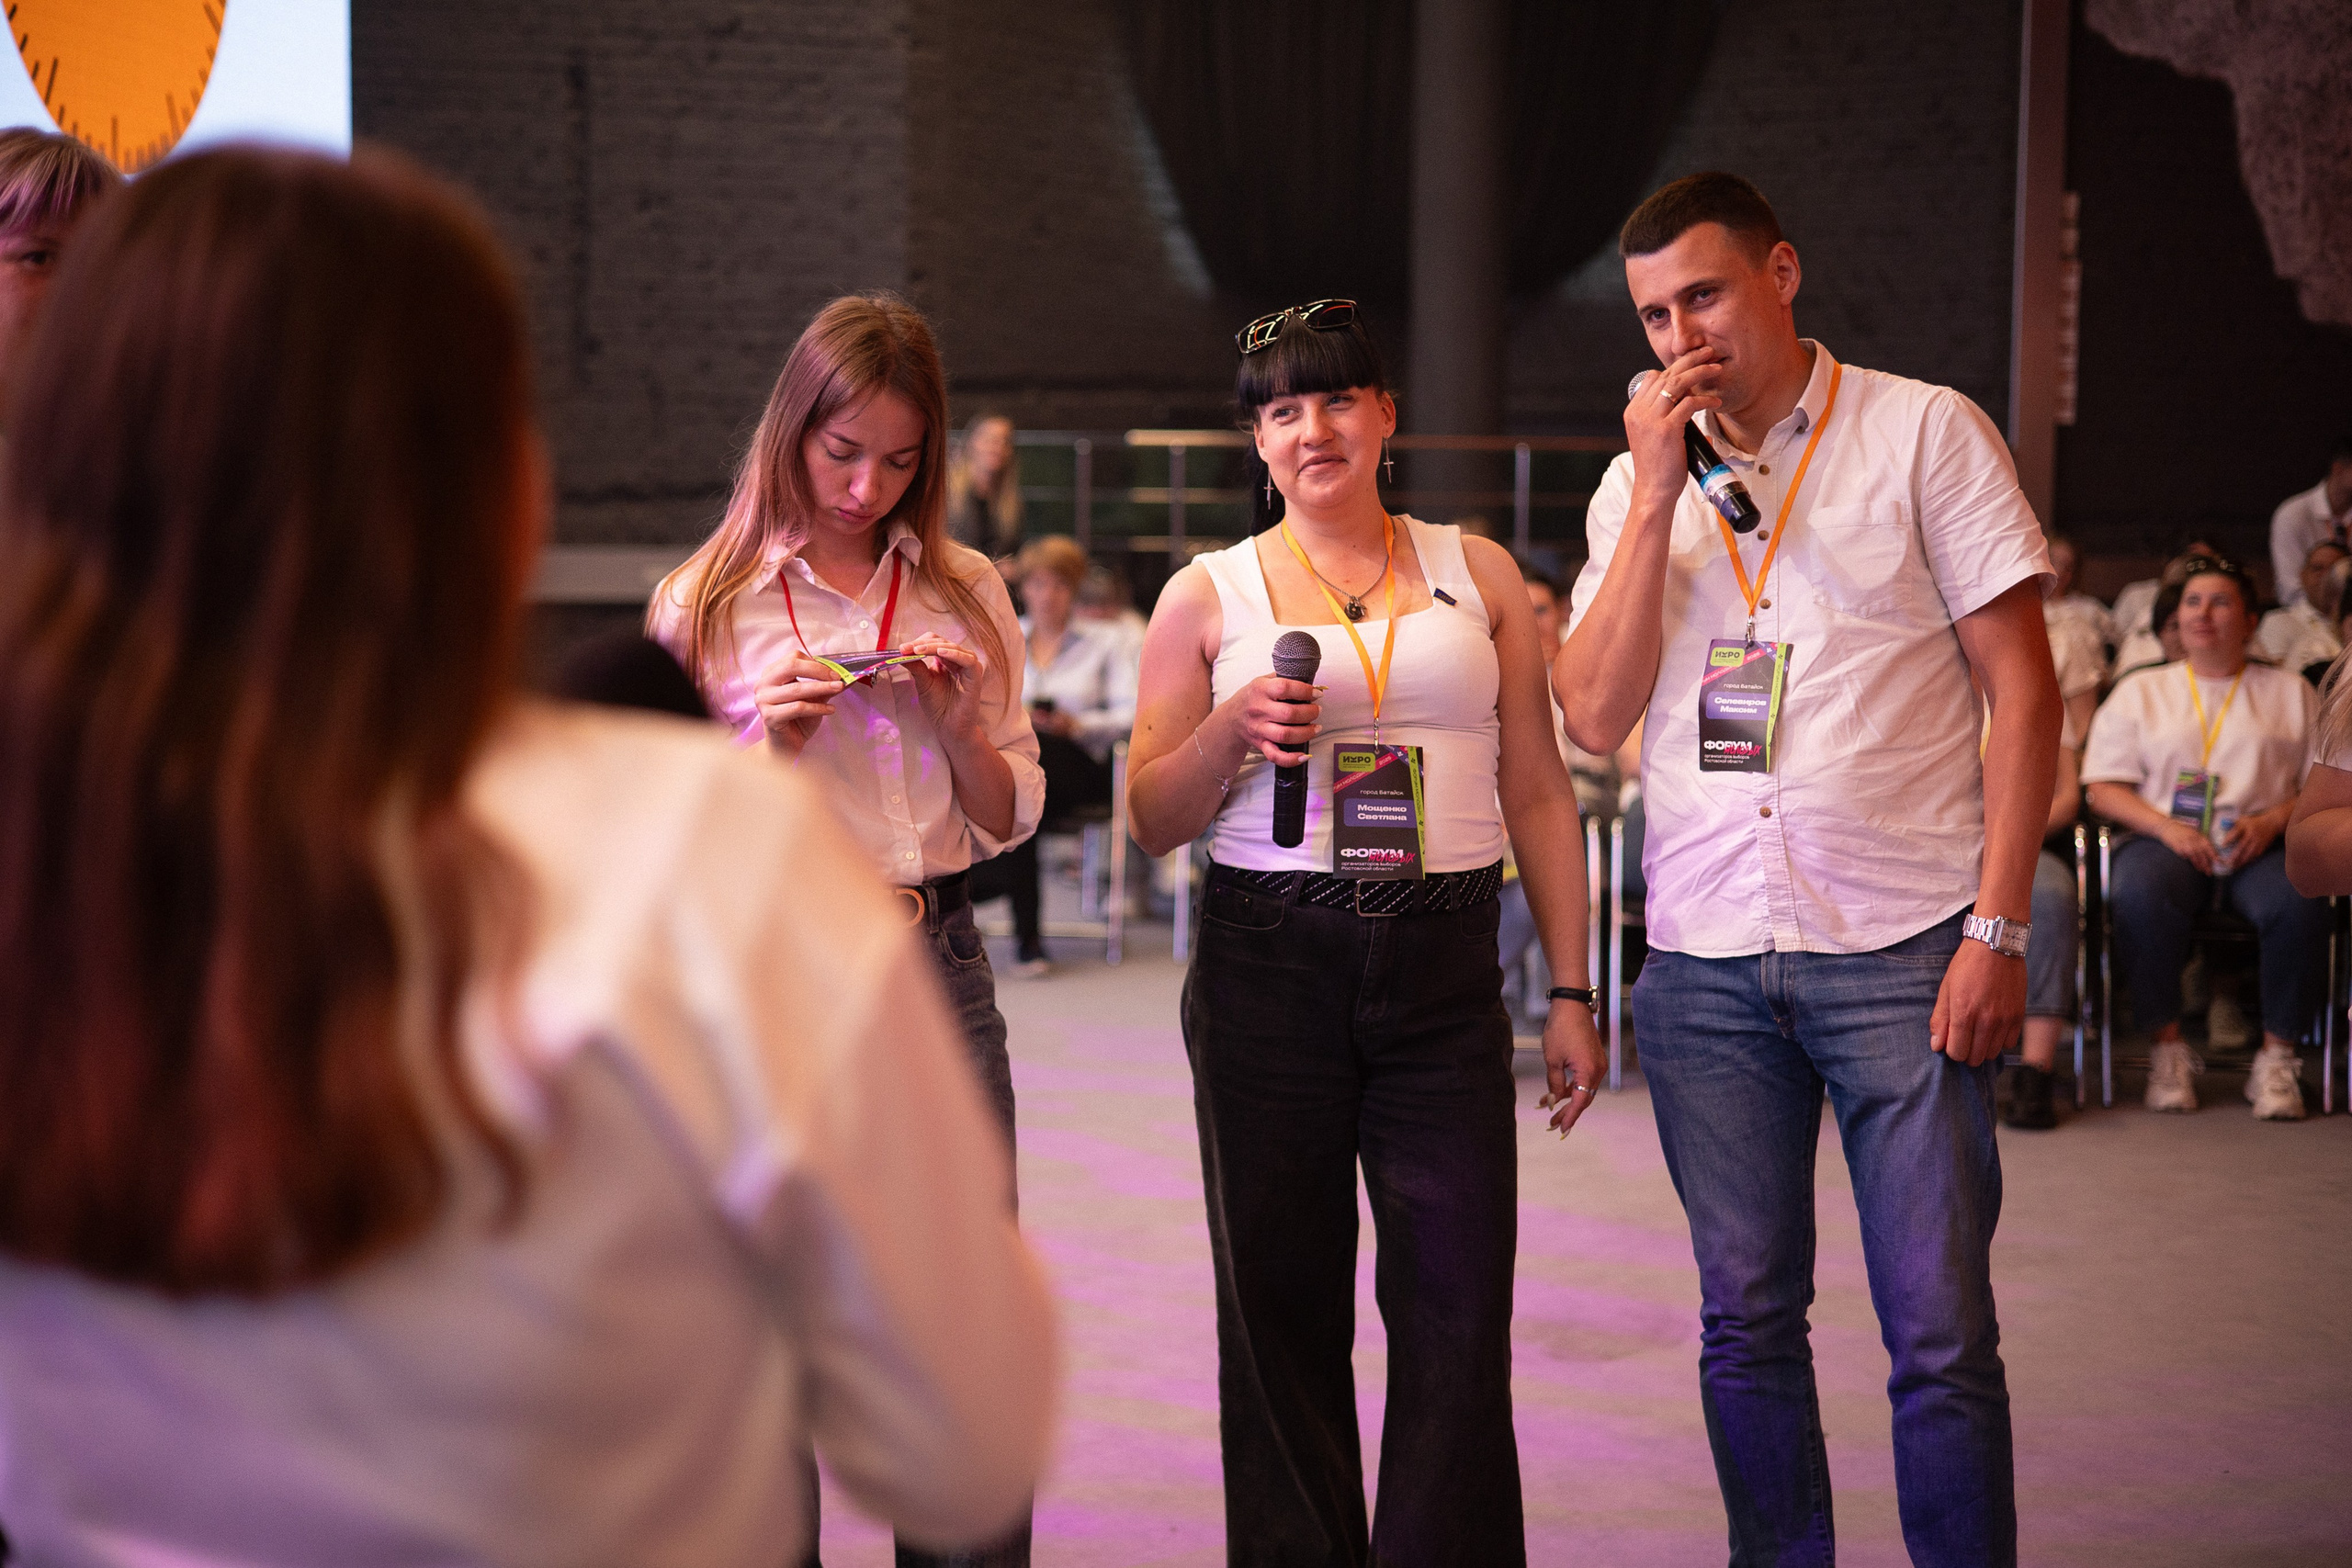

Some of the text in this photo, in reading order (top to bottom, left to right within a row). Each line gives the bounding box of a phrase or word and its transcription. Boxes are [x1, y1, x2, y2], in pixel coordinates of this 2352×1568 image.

[1720, 705, 1758, 714] Максим
[1703, 740, 1752, 750] ФОРУМ
[1357, 804, 1408, 813] Мощенко
[1357, 813, 1408, 821] Светлана
[1340, 848, 1404, 858] ФОРУМ
